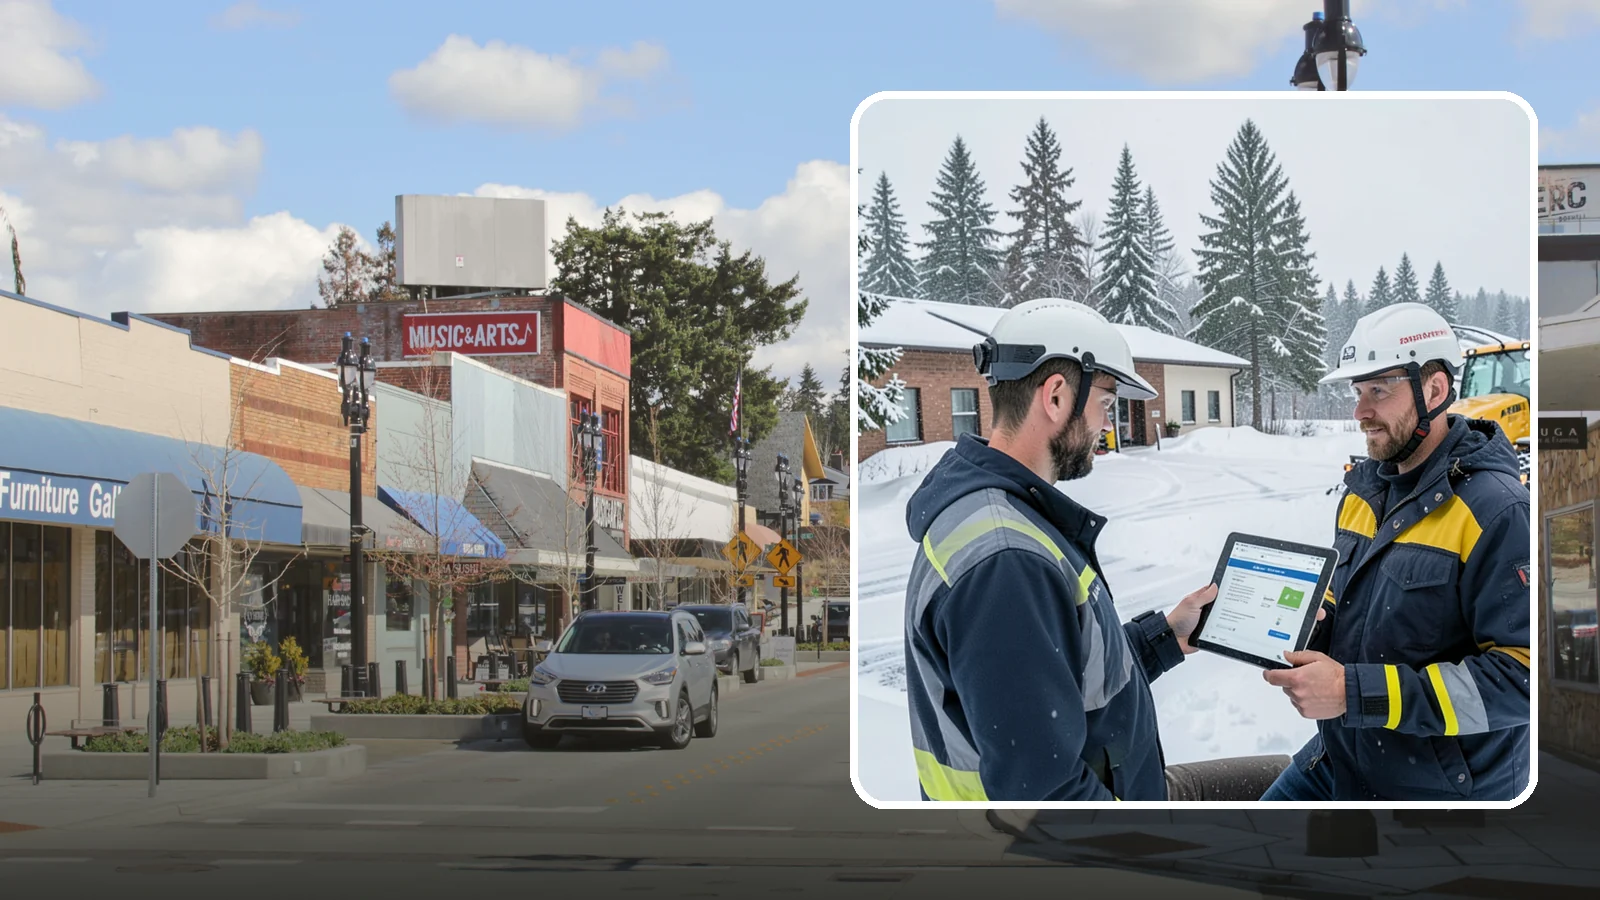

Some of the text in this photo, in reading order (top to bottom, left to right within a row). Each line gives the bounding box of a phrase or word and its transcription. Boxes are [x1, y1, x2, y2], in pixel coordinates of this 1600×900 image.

[409, 323, 519, 348] MUSIC&ARTS
[1540, 428, 1577, 436] UGA
[0, 472, 121, 519] Furniture Gal
